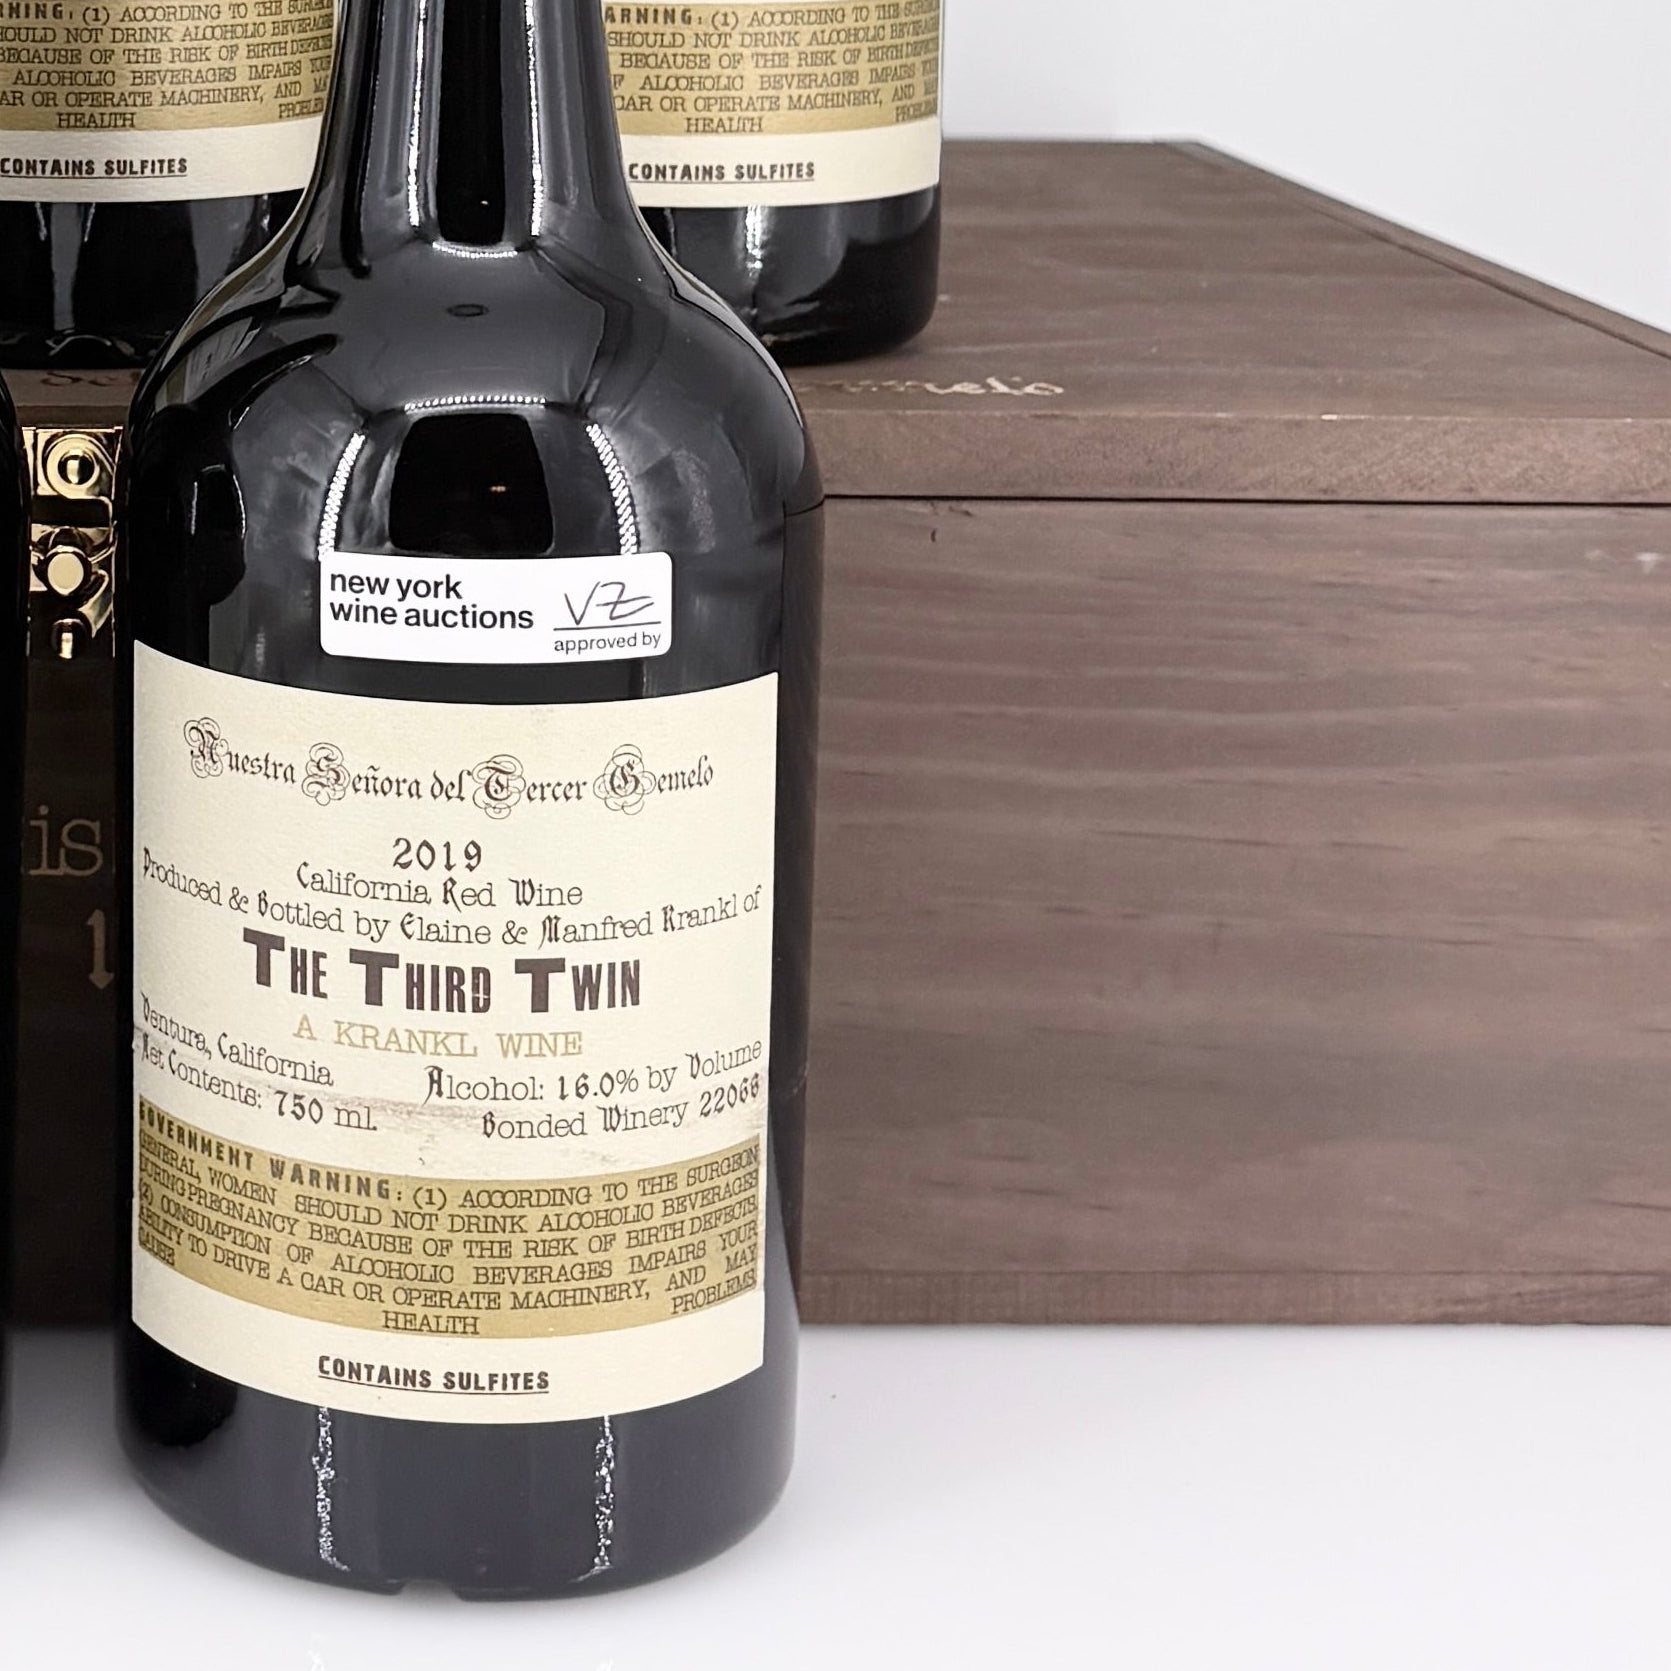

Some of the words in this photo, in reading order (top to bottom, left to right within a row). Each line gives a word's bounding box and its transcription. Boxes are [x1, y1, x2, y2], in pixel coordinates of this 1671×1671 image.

[0, 157, 95, 176] CONTAINS
[104, 158, 188, 175] SULFITES
[628, 162, 725, 181] CONTAINS
[735, 162, 815, 181] SULFITES
[331, 573, 390, 595] new
[396, 573, 463, 602] york
[330, 602, 398, 625] wine
[404, 603, 534, 629] auctions
[554, 632, 637, 655] approved
[642, 631, 661, 649] by
[301, 742, 423, 806] Señora
[430, 770, 470, 802] del
[471, 753, 587, 819] Tercer
[393, 837, 481, 872] 2019
[296, 861, 432, 905] California
[442, 876, 496, 913] Red
[508, 878, 583, 906] Wine
[243, 927, 328, 999] THE
[349, 948, 491, 1013] THIRD
[515, 957, 640, 1013] TWIN
[292, 1014, 317, 1041] A
[333, 1020, 478, 1057] KRANKL
[495, 1031, 582, 1059] WINE
[319, 1355, 431, 1388] CONTAINS
[443, 1371, 550, 1393] SULFITES
